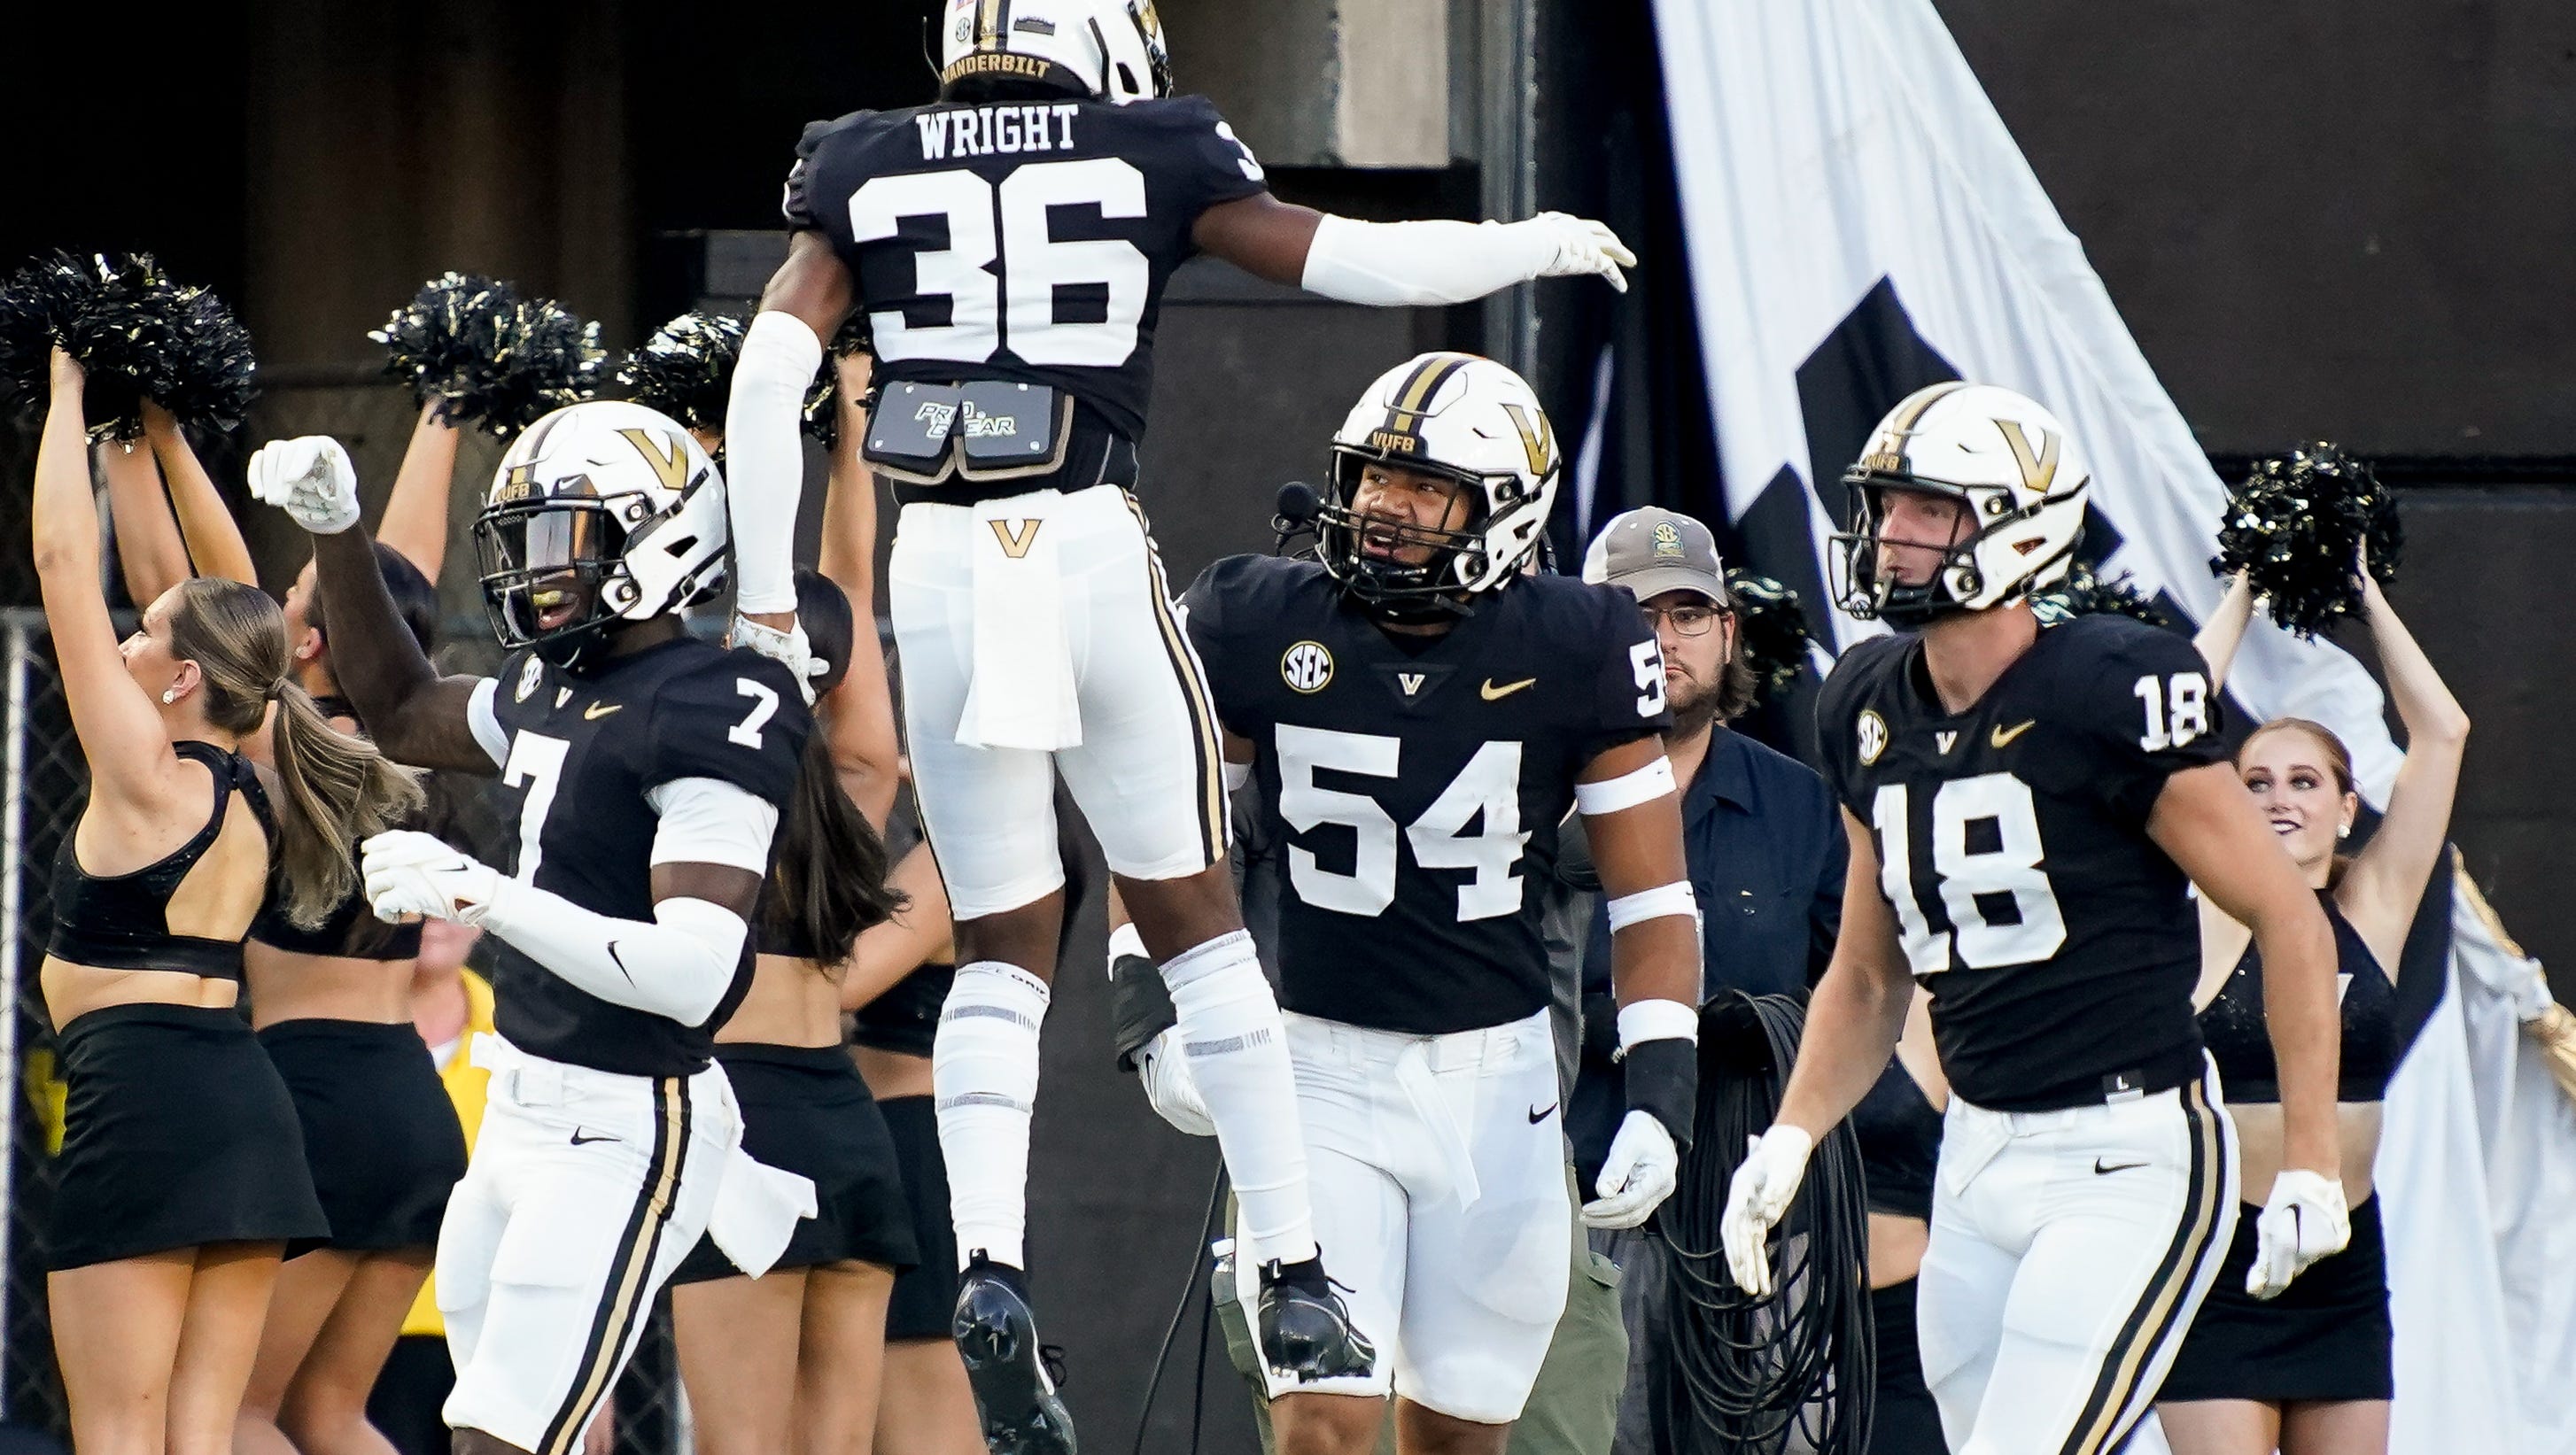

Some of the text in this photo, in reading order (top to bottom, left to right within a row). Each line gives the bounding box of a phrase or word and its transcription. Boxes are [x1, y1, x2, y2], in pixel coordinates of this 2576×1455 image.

[942, 54, 1051, 84] VANDERBILT
[916, 104, 1078, 159] WRIGHT
[849, 158, 1148, 367] 36
[613, 429, 688, 491] V
[1372, 431, 1416, 453] VUFB
[1497, 403, 1550, 476] V
[1990, 418, 2061, 493] V
[987, 518, 1043, 559] V
[555, 686, 573, 709] V
[1285, 644, 1329, 689] SEC
[1398, 673, 1425, 696] V
[1629, 631, 1669, 718] 5
[727, 677, 780, 750] 7
[1936, 730, 1958, 755] V
[2134, 672, 2208, 753] 18
[502, 728, 570, 888] 7
[1275, 722, 1532, 923] 54
[1872, 771, 2068, 976] 18
[2116, 1075, 2130, 1091] L
